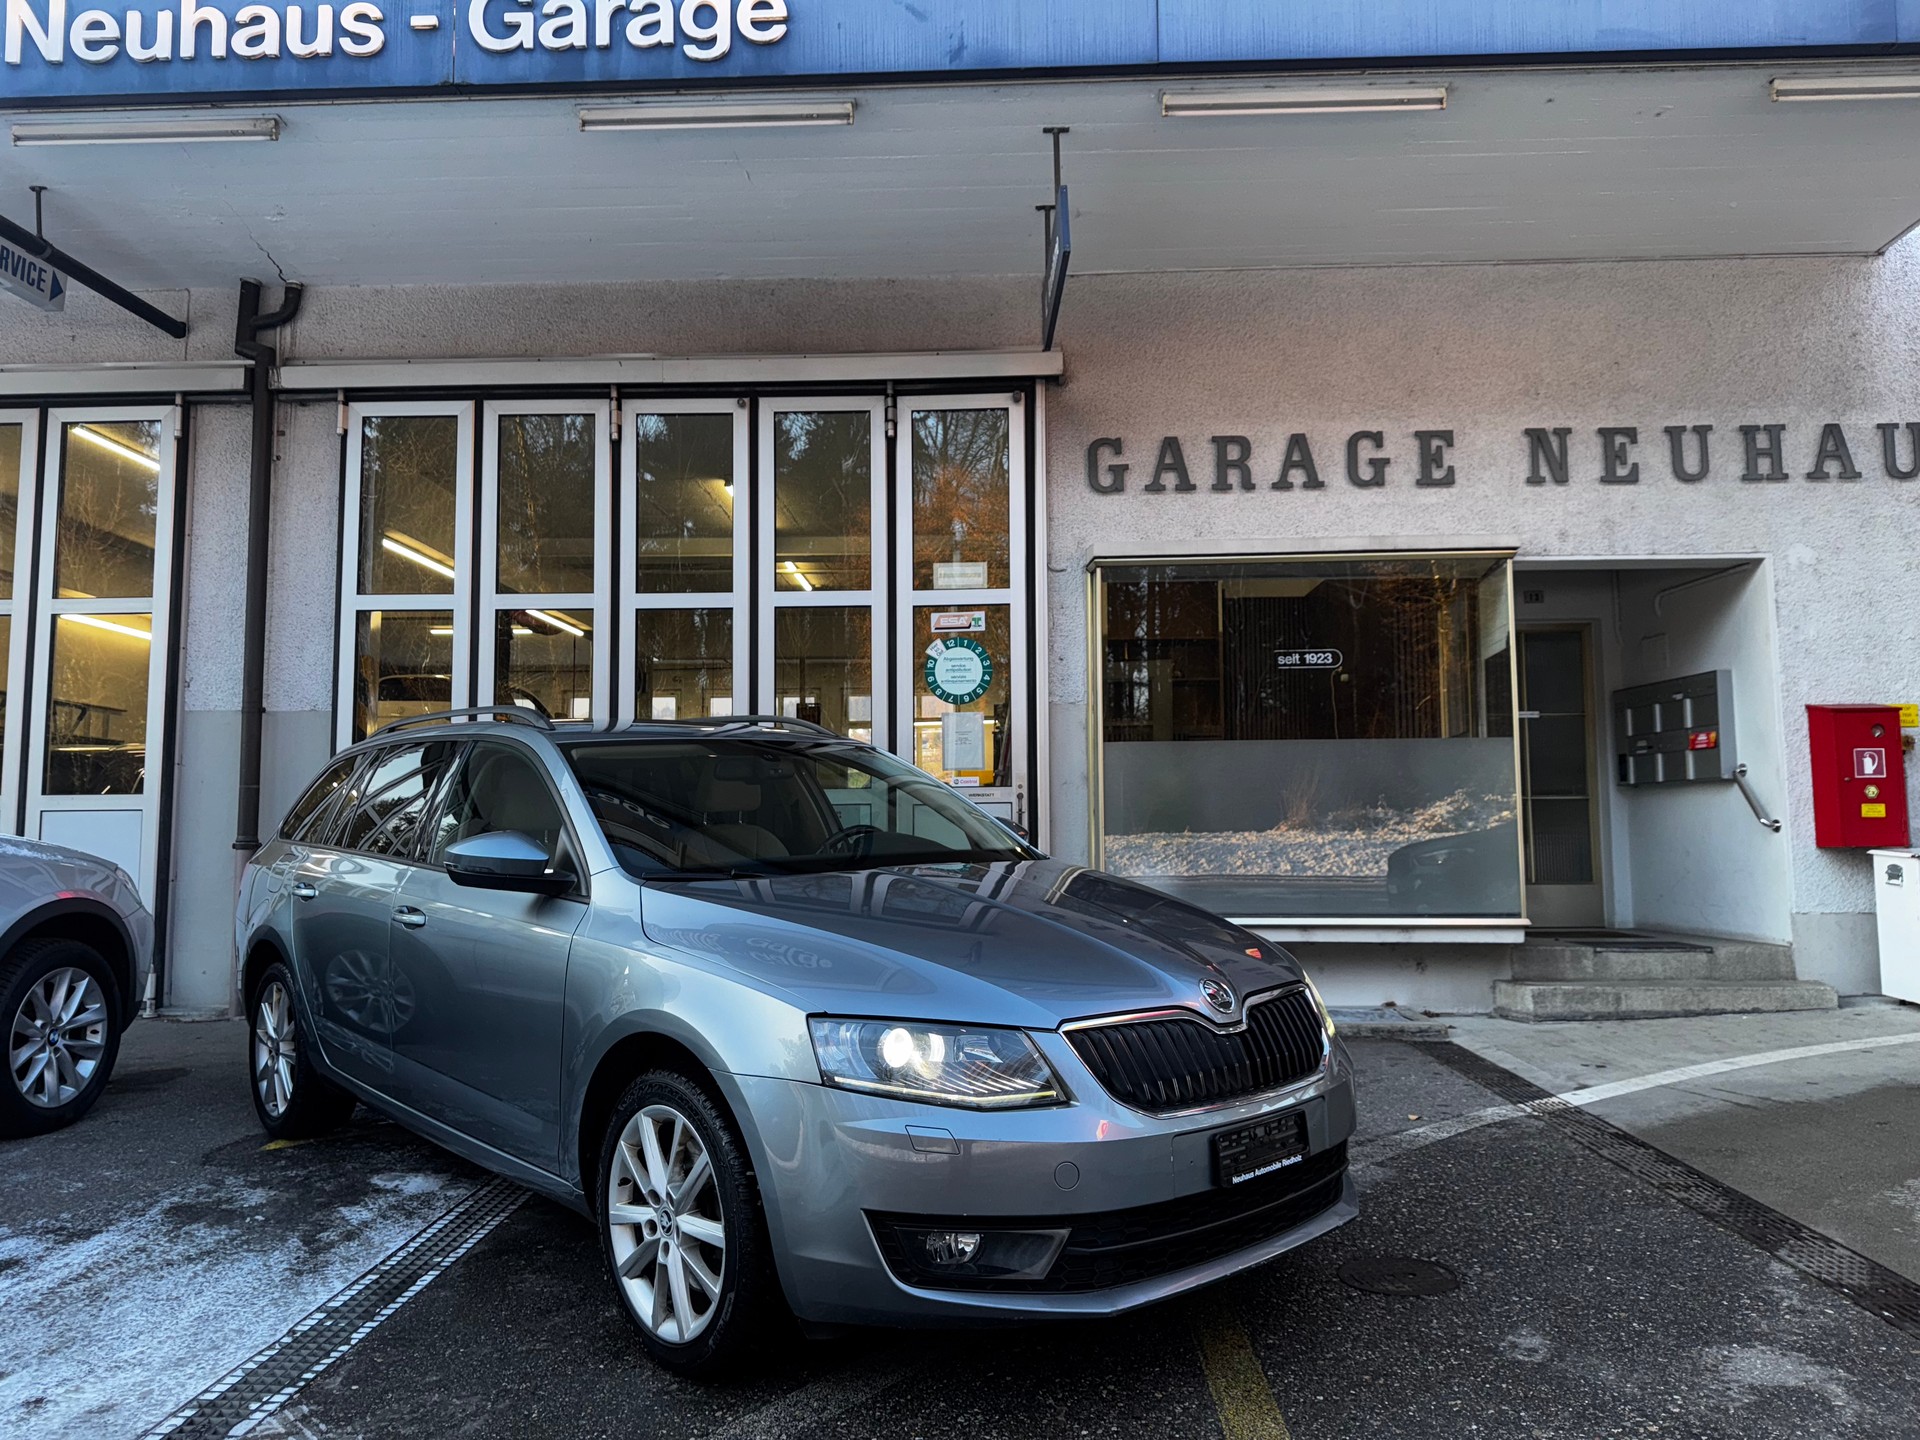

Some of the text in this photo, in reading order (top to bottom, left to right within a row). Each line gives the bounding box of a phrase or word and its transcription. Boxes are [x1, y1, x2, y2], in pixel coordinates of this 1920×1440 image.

[5, 0, 789, 65] Neuhaus - Garage
[1087, 423, 1920, 493] GARAGE NEUHAU
[927, 659, 935, 668] 10
[1277, 653, 1333, 664] seit 1923
[1232, 1172, 1254, 1184] Neuhaus
[1255, 1162, 1281, 1177] Automobile
